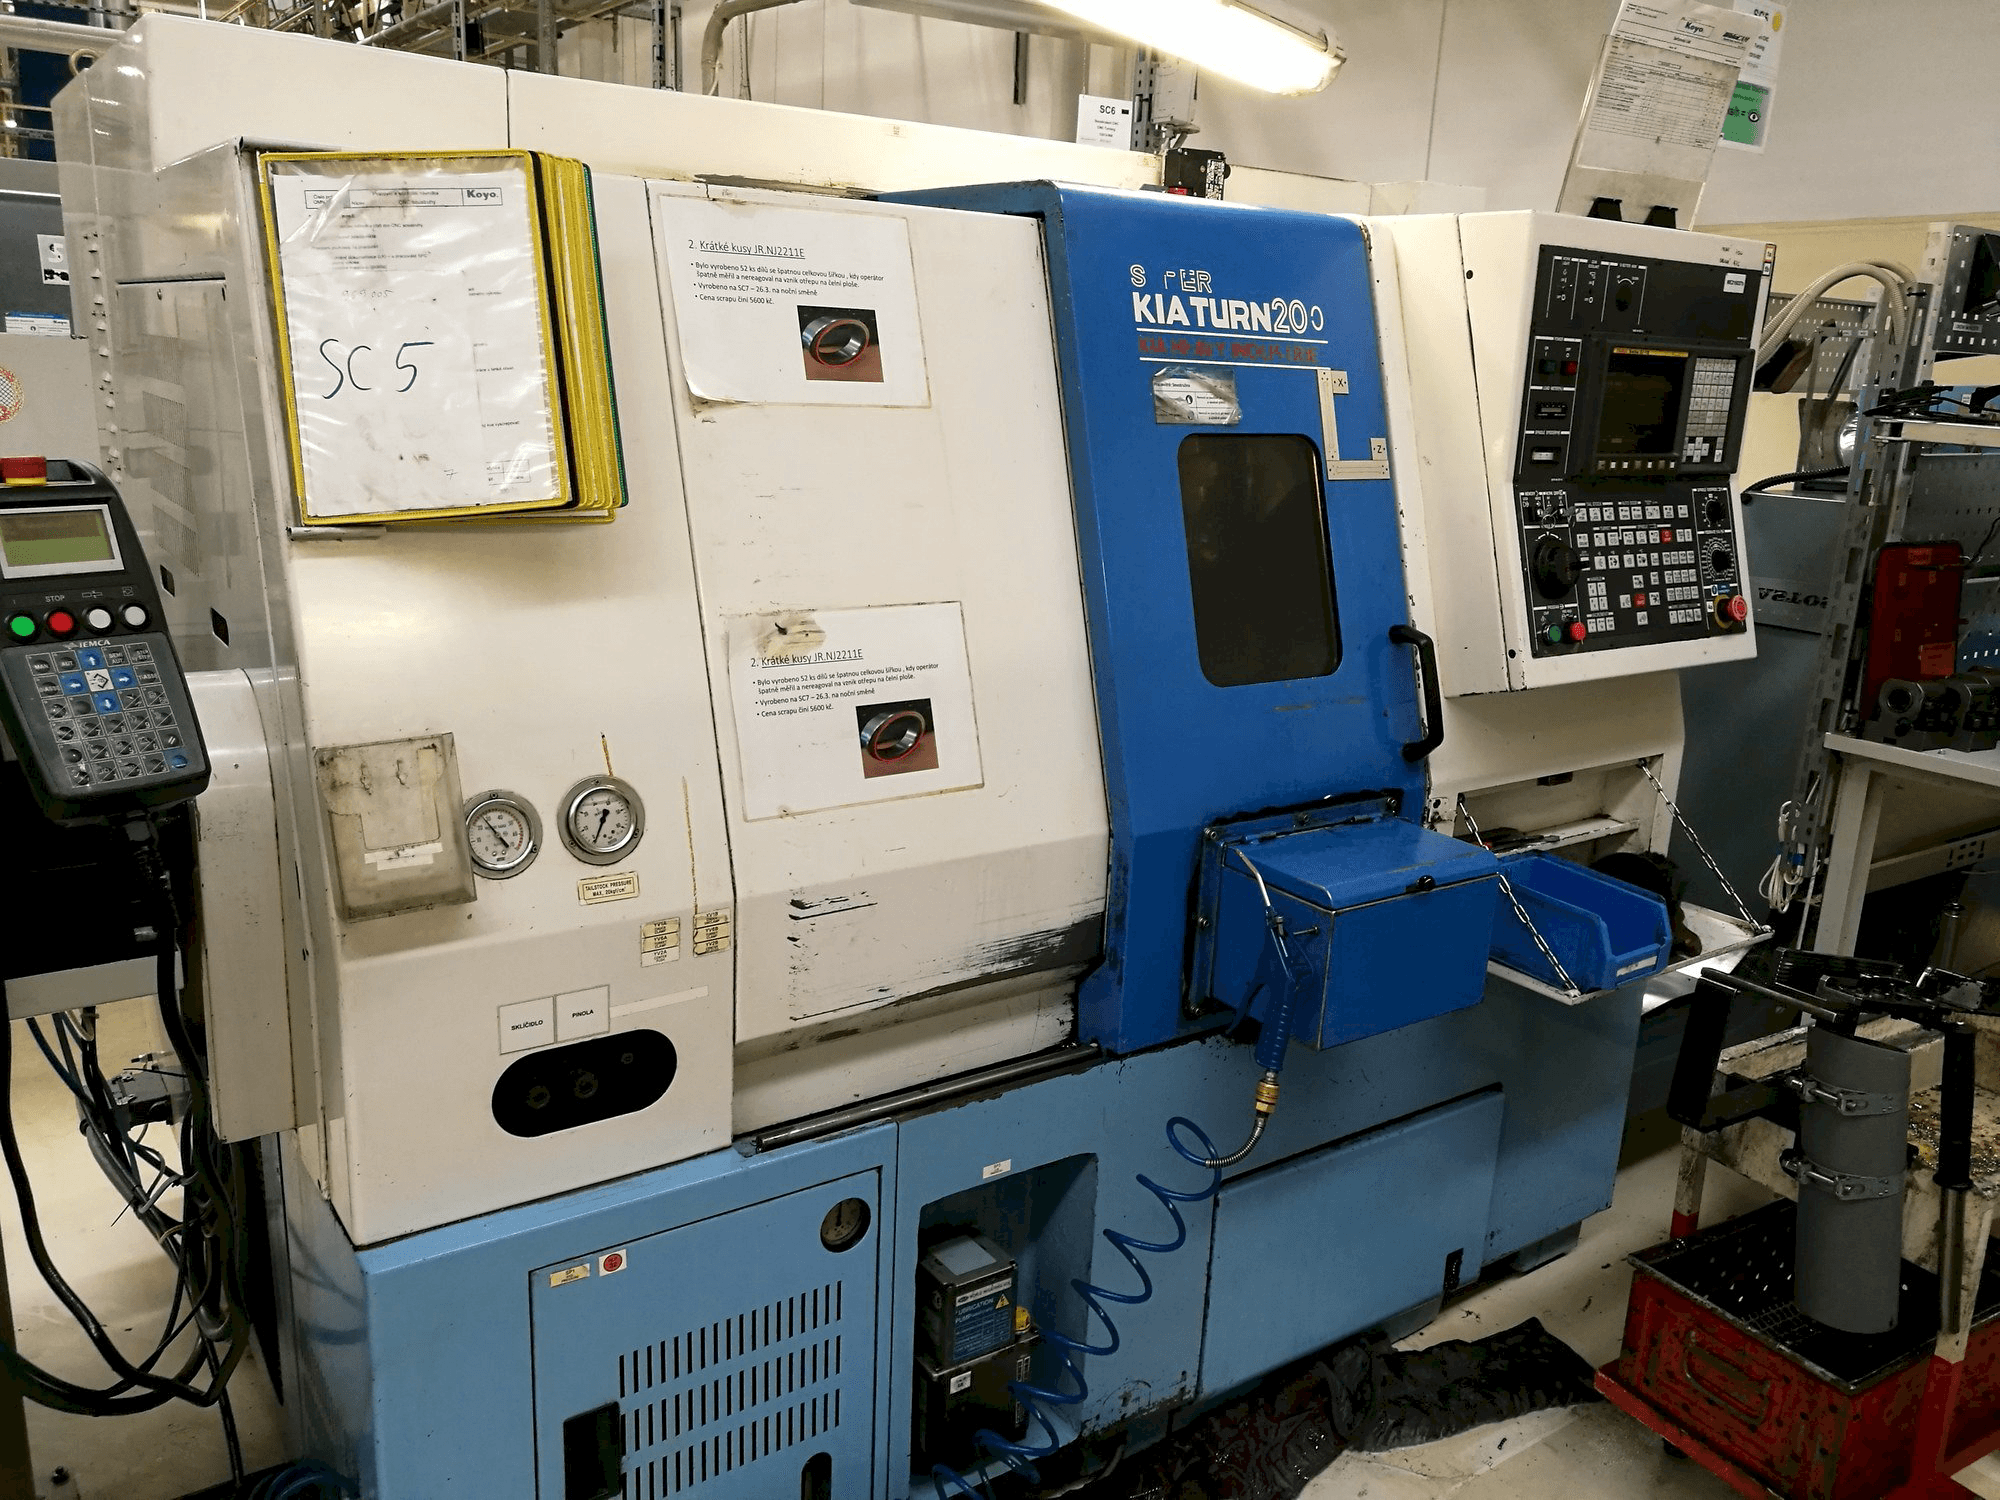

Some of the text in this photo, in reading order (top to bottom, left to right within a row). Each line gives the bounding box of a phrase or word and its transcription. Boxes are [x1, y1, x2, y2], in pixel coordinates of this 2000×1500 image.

[1685, 21, 1704, 33] Koyo
[1100, 104, 1116, 115] SC6
[466, 189, 497, 201] Koyo
[688, 239, 697, 249] 2.
[700, 240, 729, 251] Krátké
[732, 242, 752, 255] kusy
[696, 262, 709, 270] Bylo
[710, 263, 739, 271] vyrobeno
[850, 273, 859, 281] kdy
[860, 274, 884, 282] operátor
[741, 274, 774, 282] nereagoval
[698, 283, 728, 291] Vyrobeno
[319, 338, 435, 399] SC 5
[1338, 378, 1344, 387] X
[1377, 444, 1383, 454] Z
[45, 594, 65, 603] STOP
[79, 640, 111, 648] IEMCA
[751, 658, 759, 667] 2.
[762, 654, 790, 666] Krátké
[792, 654, 812, 664] kusy
[772, 676, 800, 685] vyrobeno
[916, 663, 939, 671] operátor
[802, 682, 833, 690] nereagoval
[760, 698, 789, 706] Vyrobeno
[798, 694, 810, 702] SC7
[816, 692, 830, 700] 26.3.
[761, 710, 777, 718] Cena
[778, 708, 797, 716] scrapu
[810, 704, 825, 712] 5600
[572, 1009, 594, 1018] PINOLA
[511, 1019, 544, 1031] SKLÍČIDLO
